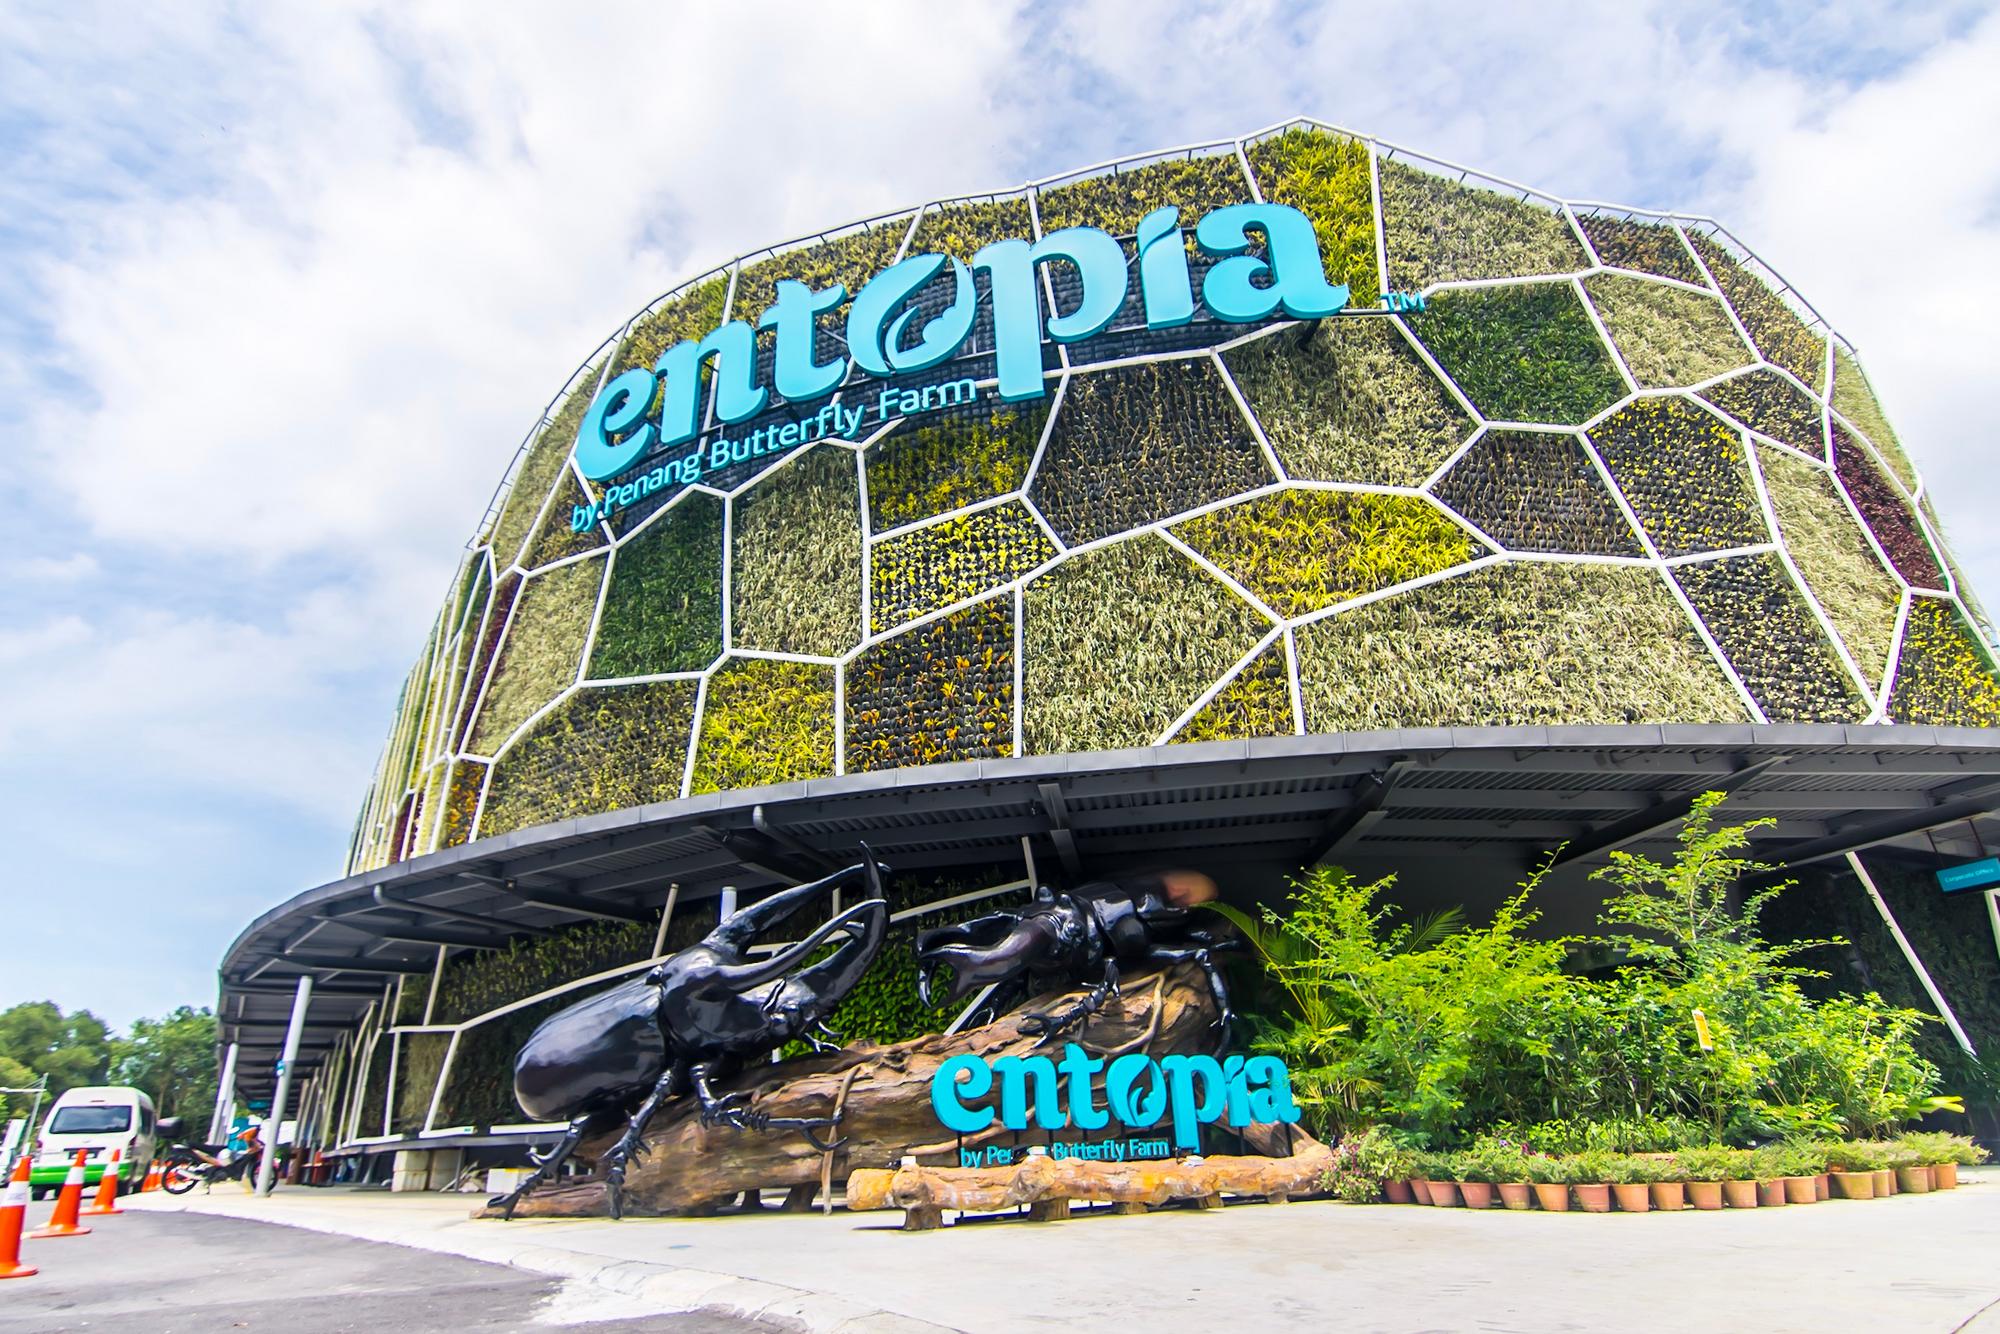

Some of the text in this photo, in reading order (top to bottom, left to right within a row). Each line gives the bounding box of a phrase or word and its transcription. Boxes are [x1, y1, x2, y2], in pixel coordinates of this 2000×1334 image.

[575, 202, 1350, 481] entopia
[571, 378, 977, 533] by Penang Butterfly Farm
[931, 1042, 1301, 1154] entopia
[960, 1147, 982, 1168] by
[1129, 1138, 1169, 1158] Farm
